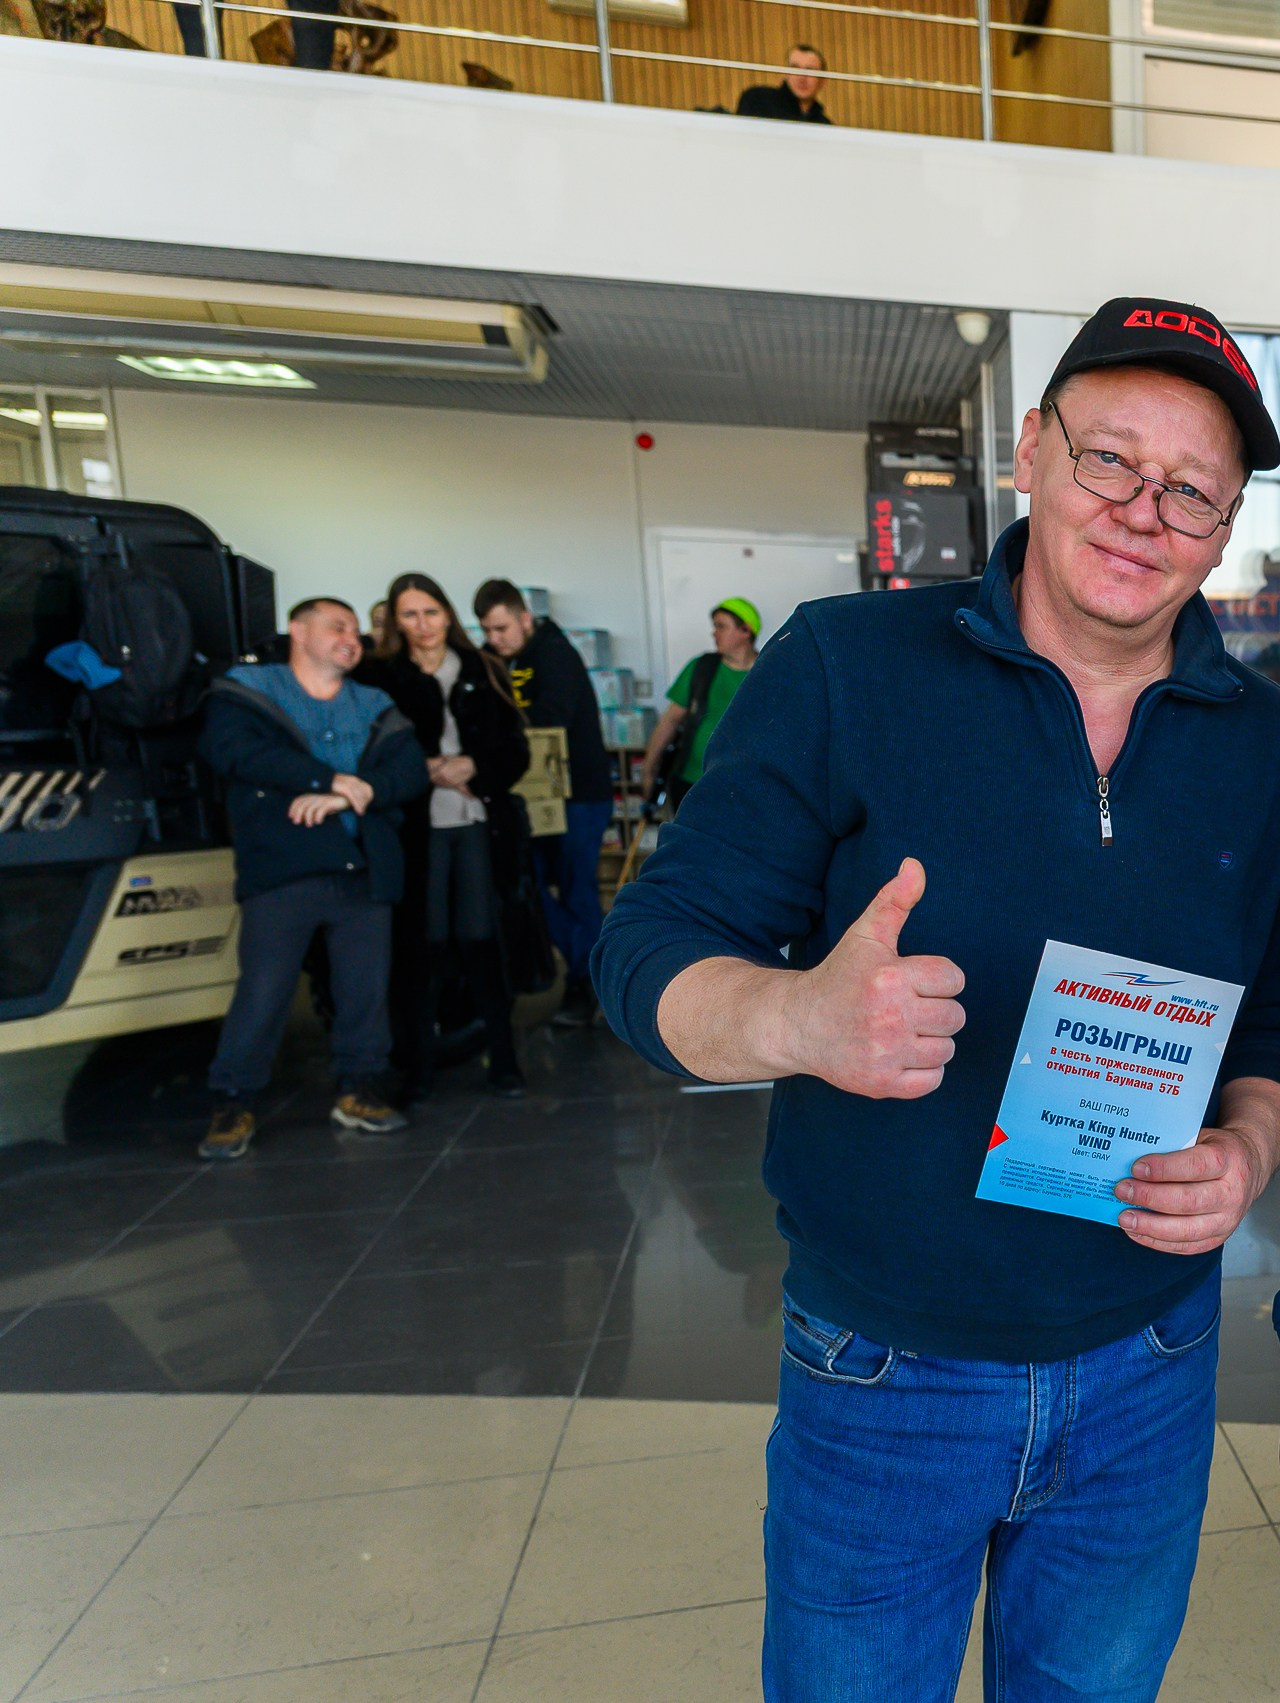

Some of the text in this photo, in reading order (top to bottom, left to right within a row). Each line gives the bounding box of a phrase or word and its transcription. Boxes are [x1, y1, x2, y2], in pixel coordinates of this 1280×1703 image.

[1053, 978, 1217, 1027] АКТИВНЫЙ ОТДЫХ
[1171, 994, 1219, 1012] www.hft.ru
[1055, 1018, 1193, 1065] РОЗЫГРЫШ
[1046, 1061, 1180, 1096] открытия Баумана 57Б
[1050, 1047, 1184, 1082] в честь торжественного
[1080, 1099, 1130, 1118] ВАШ ПРИЗ
[1041, 1110, 1160, 1145] Куртка King Hunter
[1078, 1134, 1111, 1151] WIND
[1072, 1148, 1111, 1161] Цвет: GRAY
